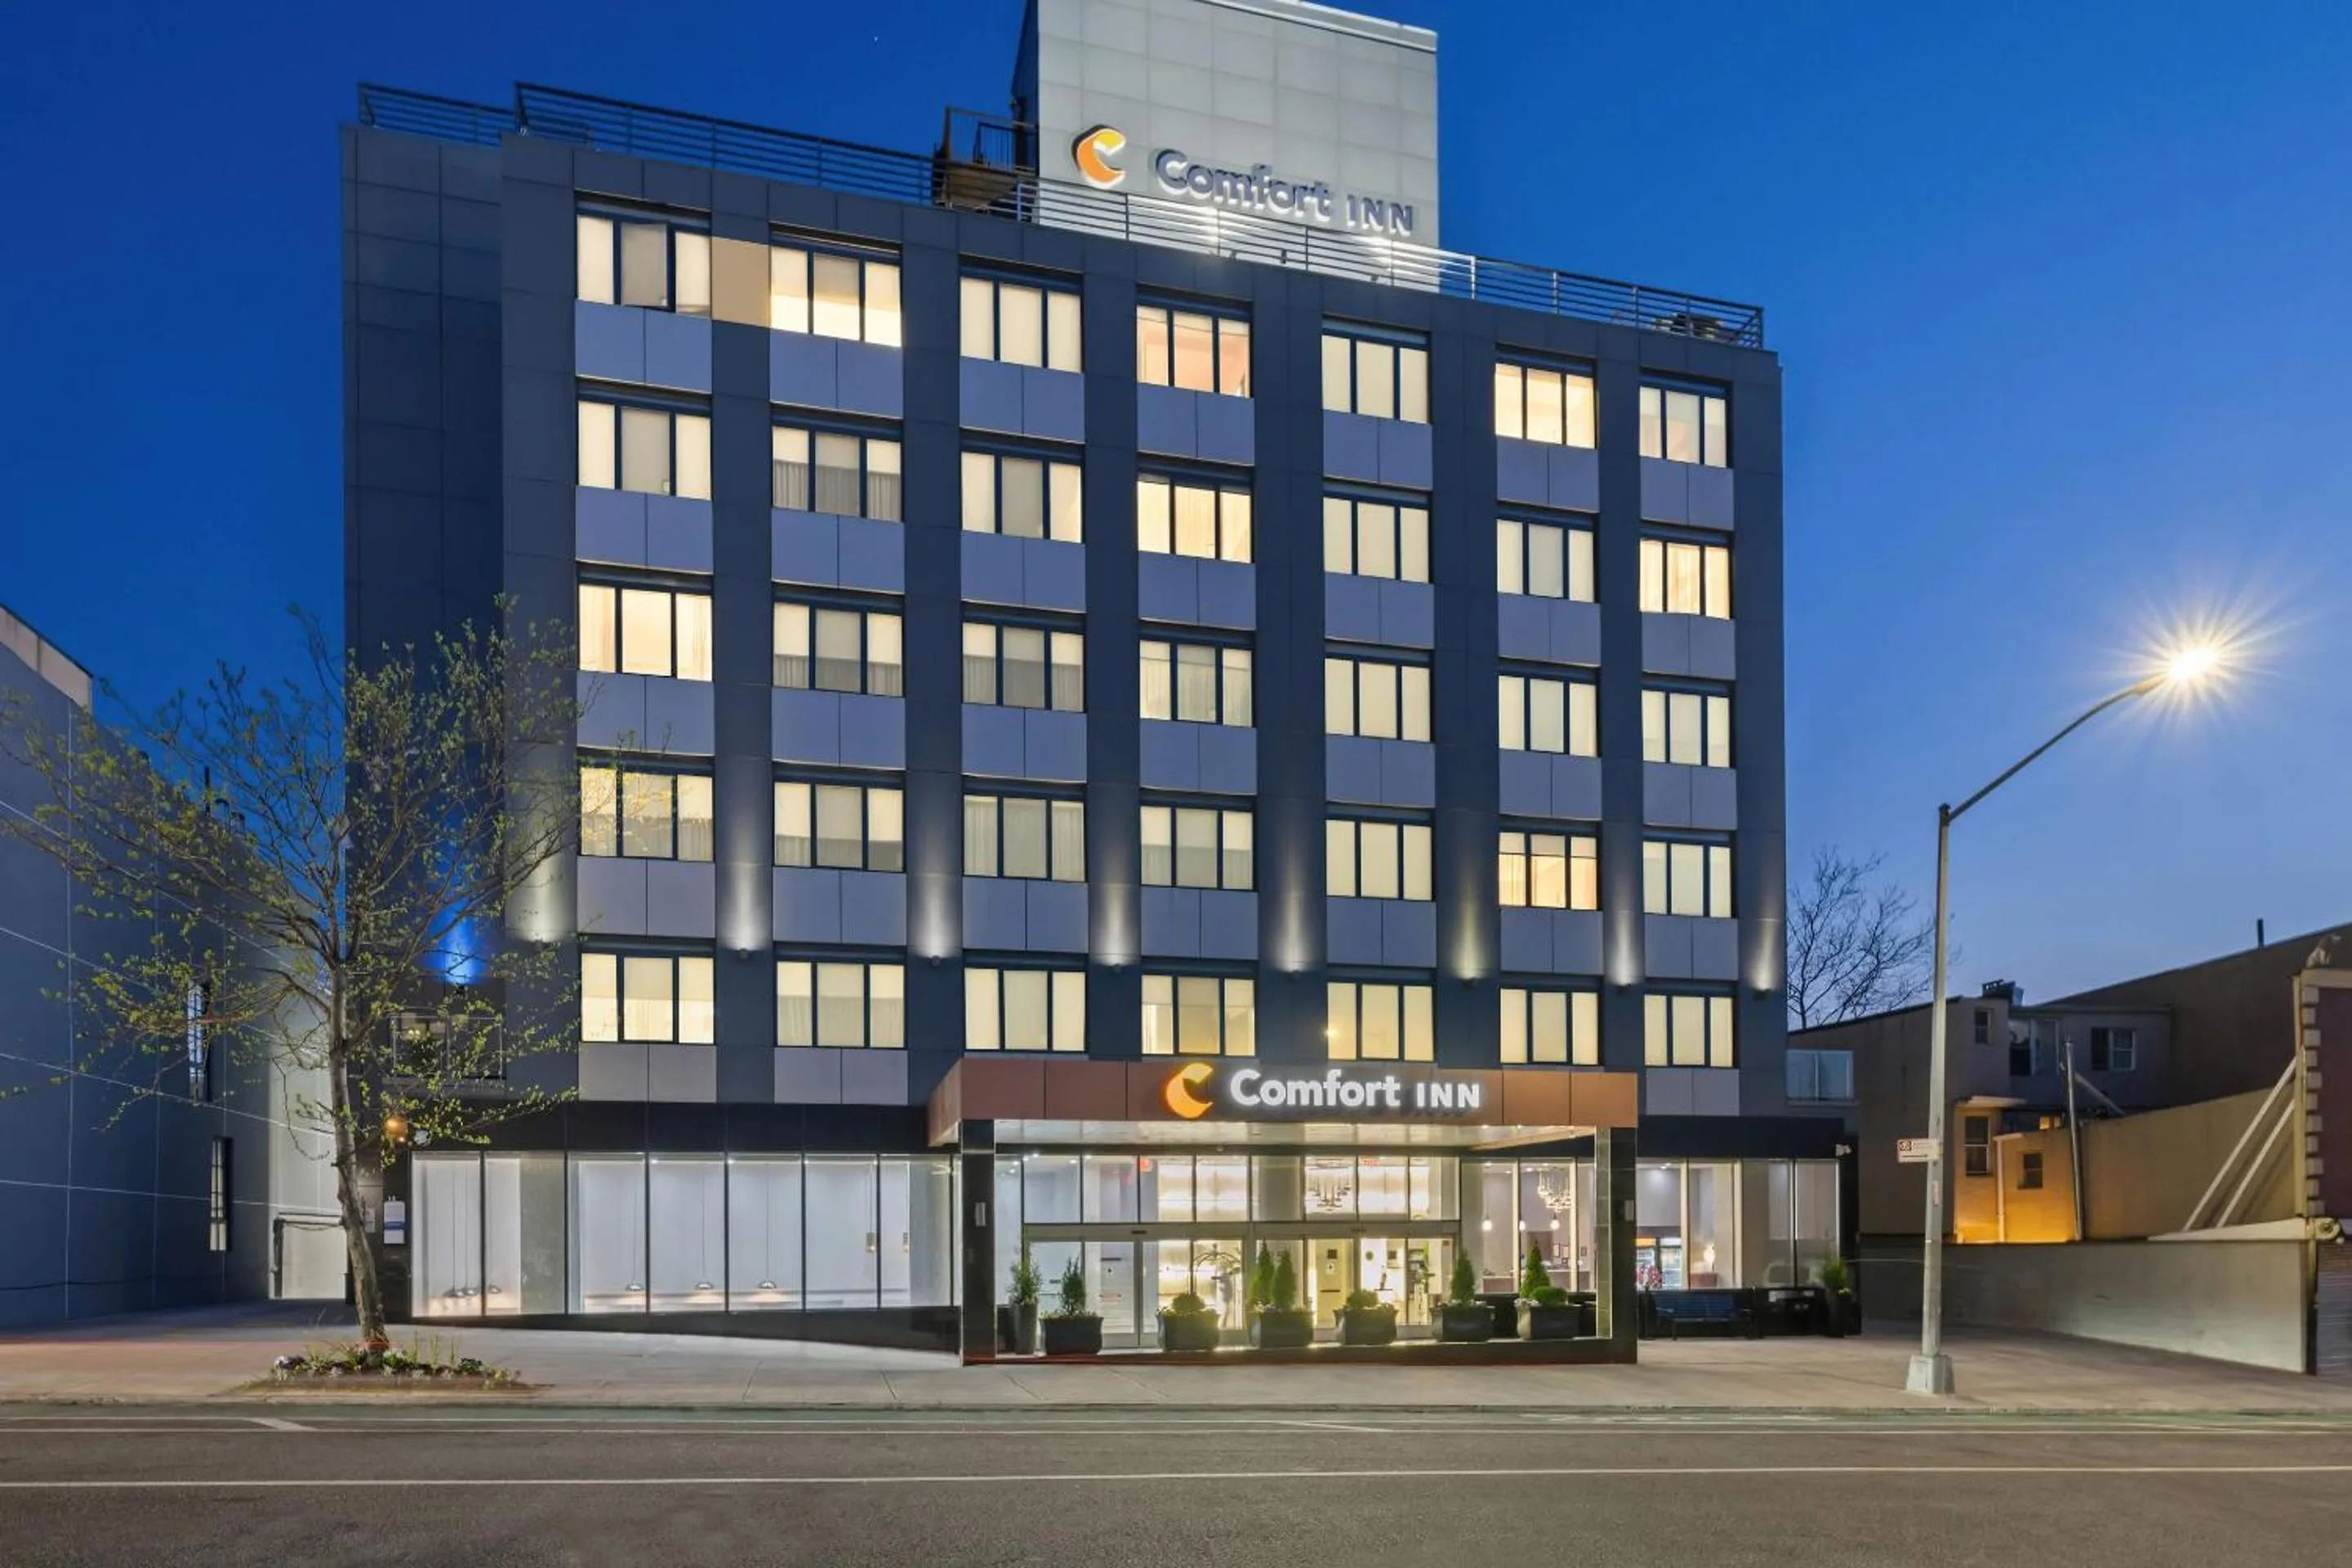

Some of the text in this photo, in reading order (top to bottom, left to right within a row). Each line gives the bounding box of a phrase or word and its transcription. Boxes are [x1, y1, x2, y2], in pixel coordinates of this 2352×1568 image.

[1156, 149, 1333, 221] Comfort
[1347, 194, 1414, 237] INN
[1231, 1069, 1401, 1107] Comfort
[1417, 1083, 1480, 1108] INN
